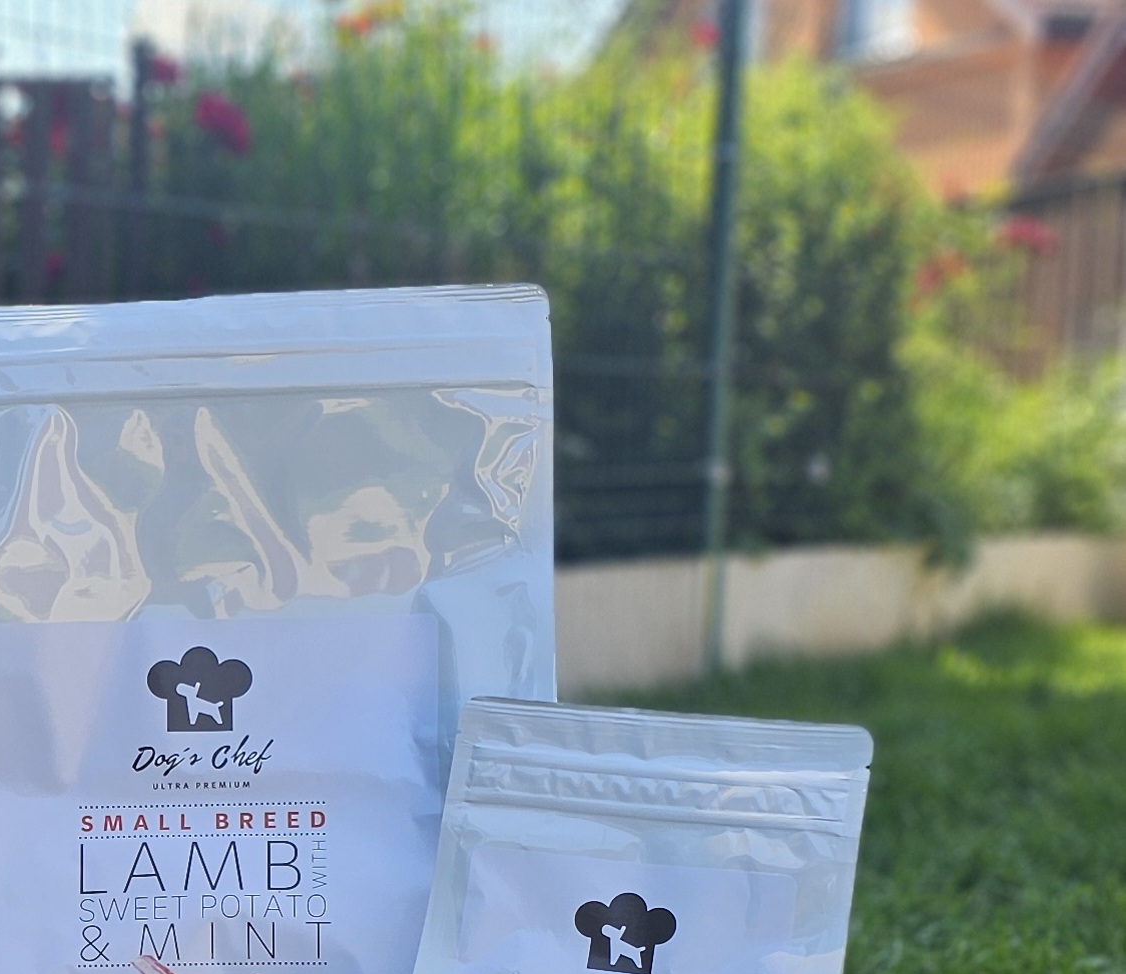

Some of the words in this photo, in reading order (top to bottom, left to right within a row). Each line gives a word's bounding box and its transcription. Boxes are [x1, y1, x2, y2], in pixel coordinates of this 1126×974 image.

[211, 735, 274, 774] Chef
[152, 782, 190, 790] ULTRA
[195, 781, 251, 790] PREMIUM
[81, 813, 192, 832] SMALL
[215, 811, 327, 830] BREED
[79, 840, 302, 894] LAMB
[311, 840, 328, 889] WITH
[79, 895, 188, 923] SWEET
[200, 893, 328, 919] POTATO
[79, 924, 110, 962] &
[139, 921, 332, 961] MINT
